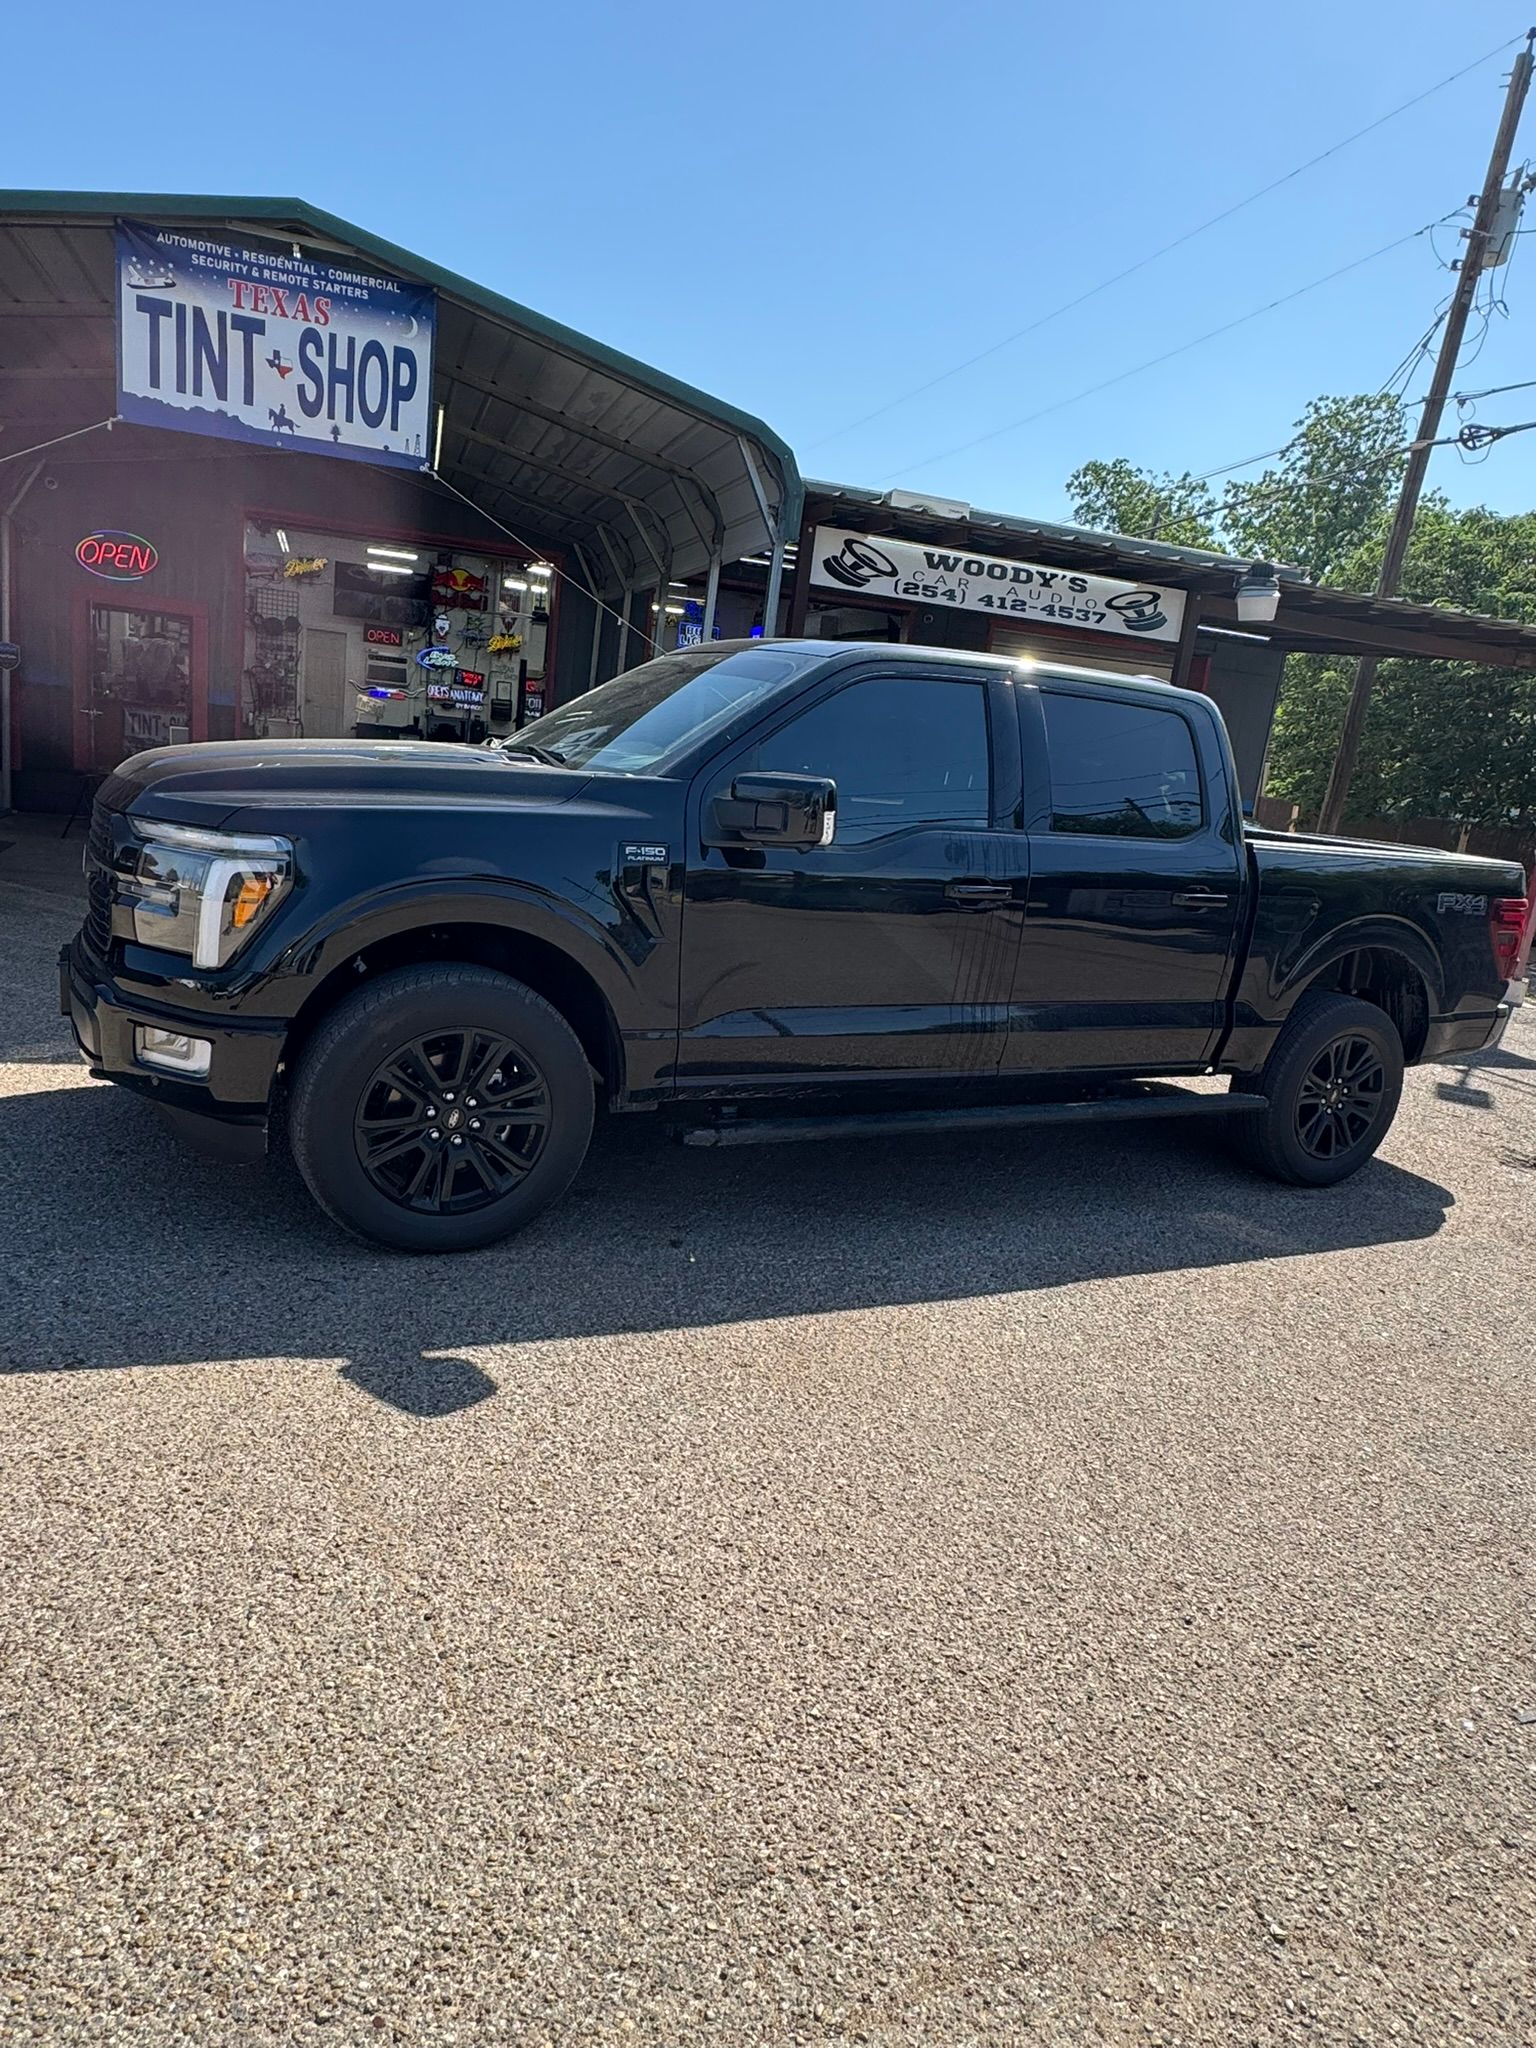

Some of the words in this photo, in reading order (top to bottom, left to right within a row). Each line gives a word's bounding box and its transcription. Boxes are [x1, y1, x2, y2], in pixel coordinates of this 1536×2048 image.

[157, 232, 231, 258] AUTOMOTIVE
[242, 250, 317, 276] RESIDENTIAL
[328, 269, 401, 293] COMMERCIAL
[191, 253, 248, 275] SECURITY
[251, 267, 260, 277] &
[263, 269, 309, 288] REMOTE
[312, 279, 369, 300] STARTERS
[227, 277, 331, 327] TEXAS
[135, 294, 266, 407] TINT
[296, 326, 418, 432] SHOP
[79, 539, 151, 571] OPEN
[923, 551, 1089, 594] WOODY'S
[893, 578, 967, 605] (254)
[977, 594, 1107, 625] 412-4537
[912, 570, 970, 589] CAR
[1006, 586, 1098, 610] AUDIO
[367, 629, 400, 644] OPEN
[128, 711, 162, 736] TINT
[625, 846, 666, 856] F-150
[1436, 892, 1488, 916] FX4
